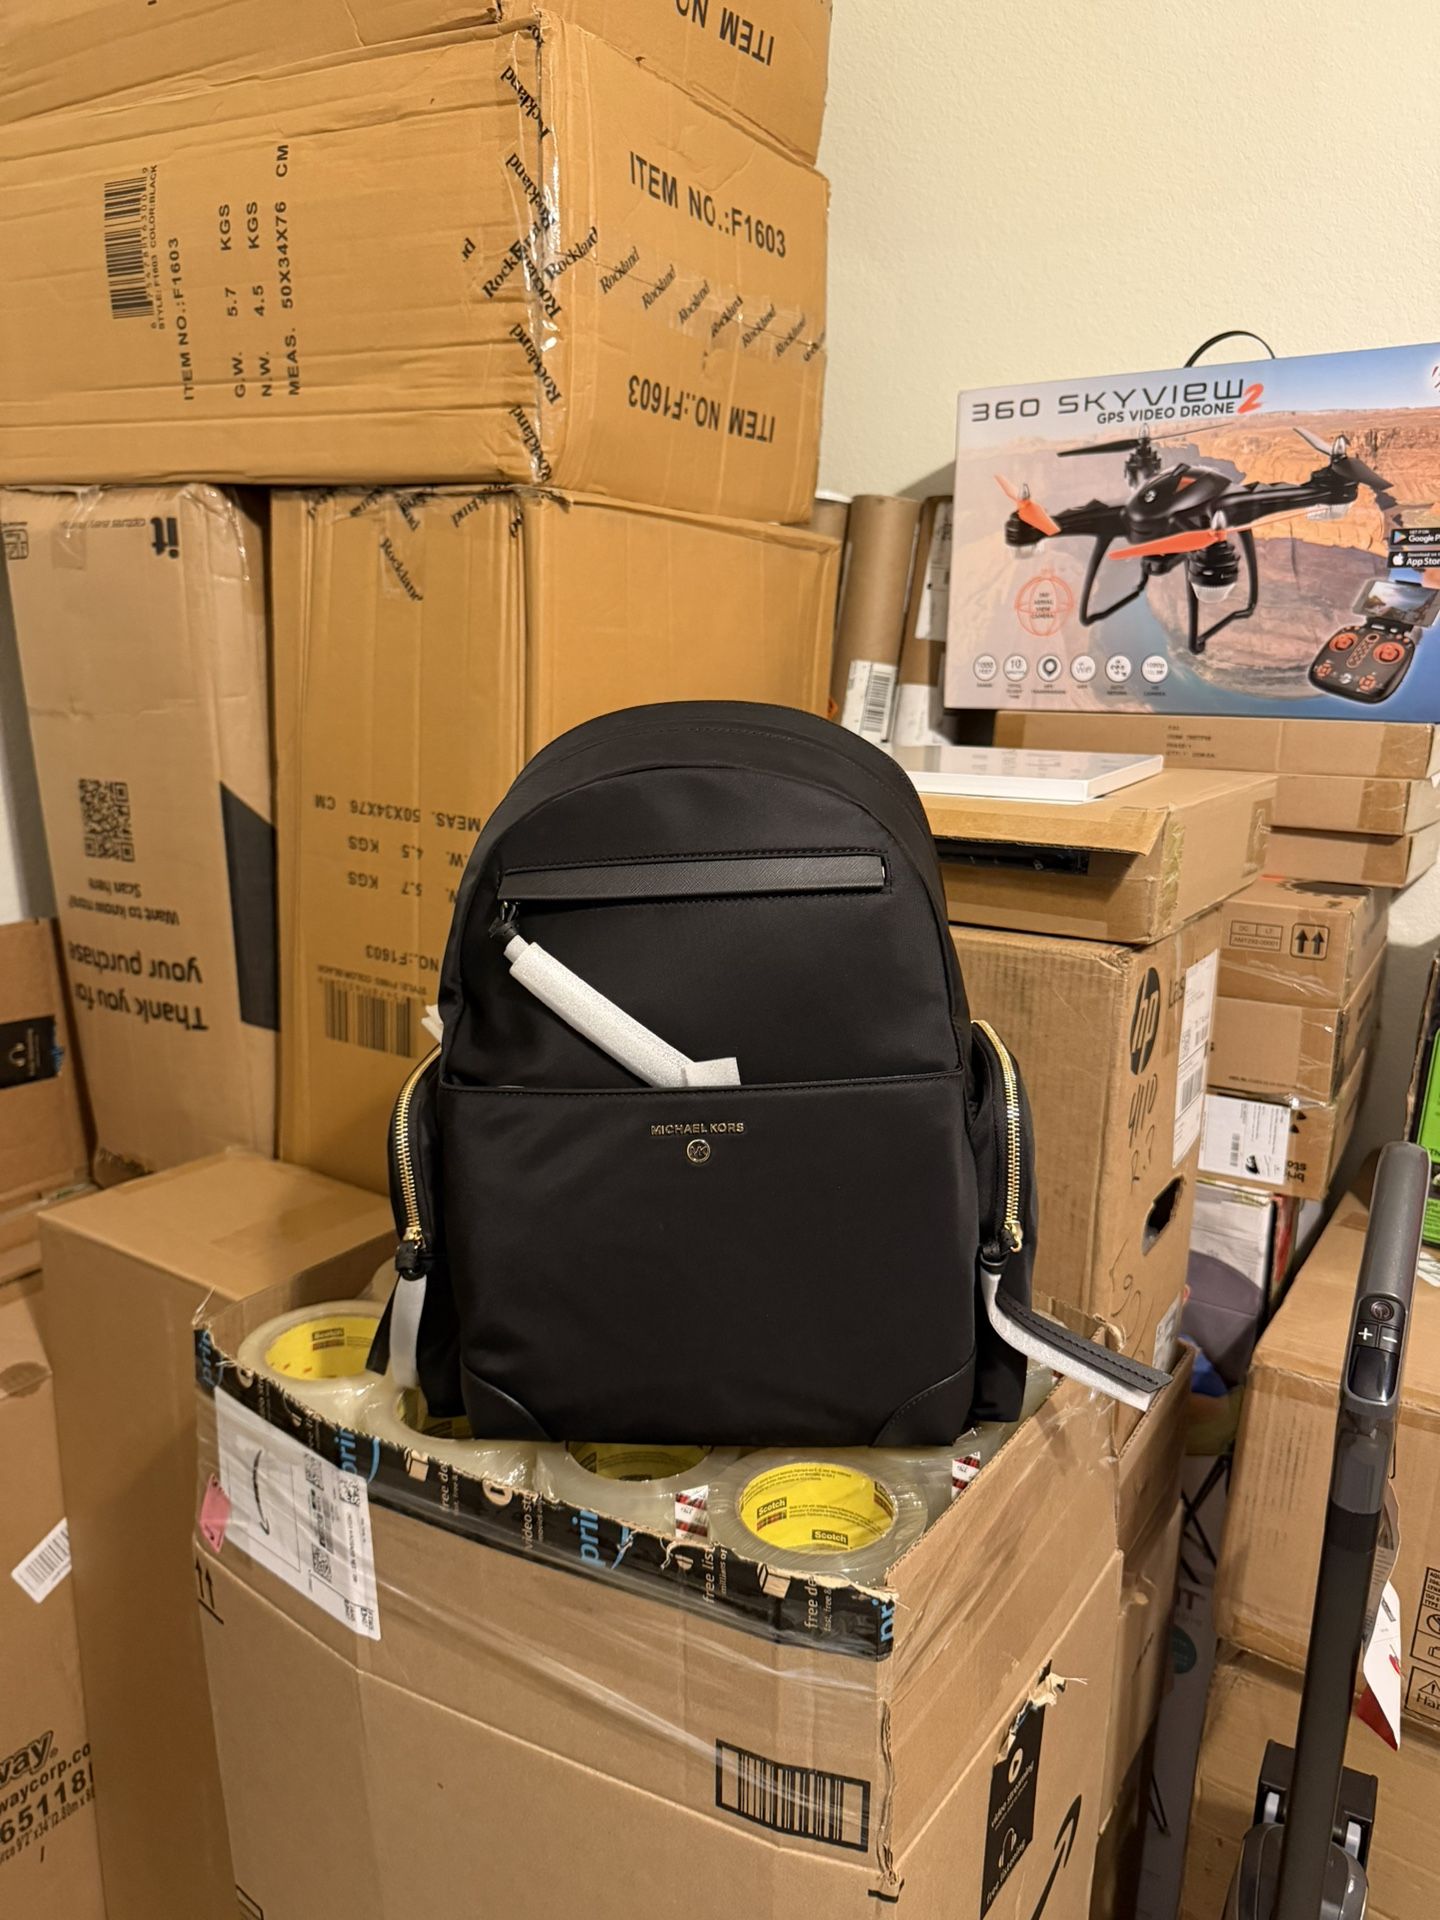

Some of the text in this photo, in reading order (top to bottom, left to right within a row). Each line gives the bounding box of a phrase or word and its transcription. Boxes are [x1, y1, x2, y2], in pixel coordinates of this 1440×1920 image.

[718, 18, 776, 67] ITEM
[628, 151, 788, 259] ITEM NO.:F1603
[543, 226, 599, 281] Rockland
[275, 144, 301, 396] MEAS. 50X34X76 CM
[598, 246, 641, 295] Rockland
[218, 203, 247, 399] G.W. 5.7 KGS
[245, 201, 273, 398] N.W. 4.5 KGS
[182, 350, 195, 401] ITEM
[971, 397, 1042, 423] 360
[1237, 382, 1265, 415] 2
[1096, 401, 1235, 425] GPS VIDEO DRONE
[728, 414, 776, 444] ITEM
[1408, 533, 1434, 543] Google
[1405, 557, 1423, 567] App
[314, 794, 336, 811] CM
[431, 811, 481, 832] MEAS.
[347, 835, 380, 854] KGS
[111, 883, 142, 899] Scan
[347, 870, 379, 890] KGS
[127, 906, 145, 921] to
[143, 909, 180, 927] Want
[147, 956, 204, 984] your
[100, 989, 131, 1014] you
[135, 1000, 209, 1031] Thank
[650, 1122, 745, 1136] MICHAEL KORS
[758, 1499, 786, 1517] Scotch
[521, 1513, 534, 1552] video
[813, 1530, 848, 1544] Scotch
[702, 1573, 716, 1604] free
[804, 1599, 819, 1629] free
